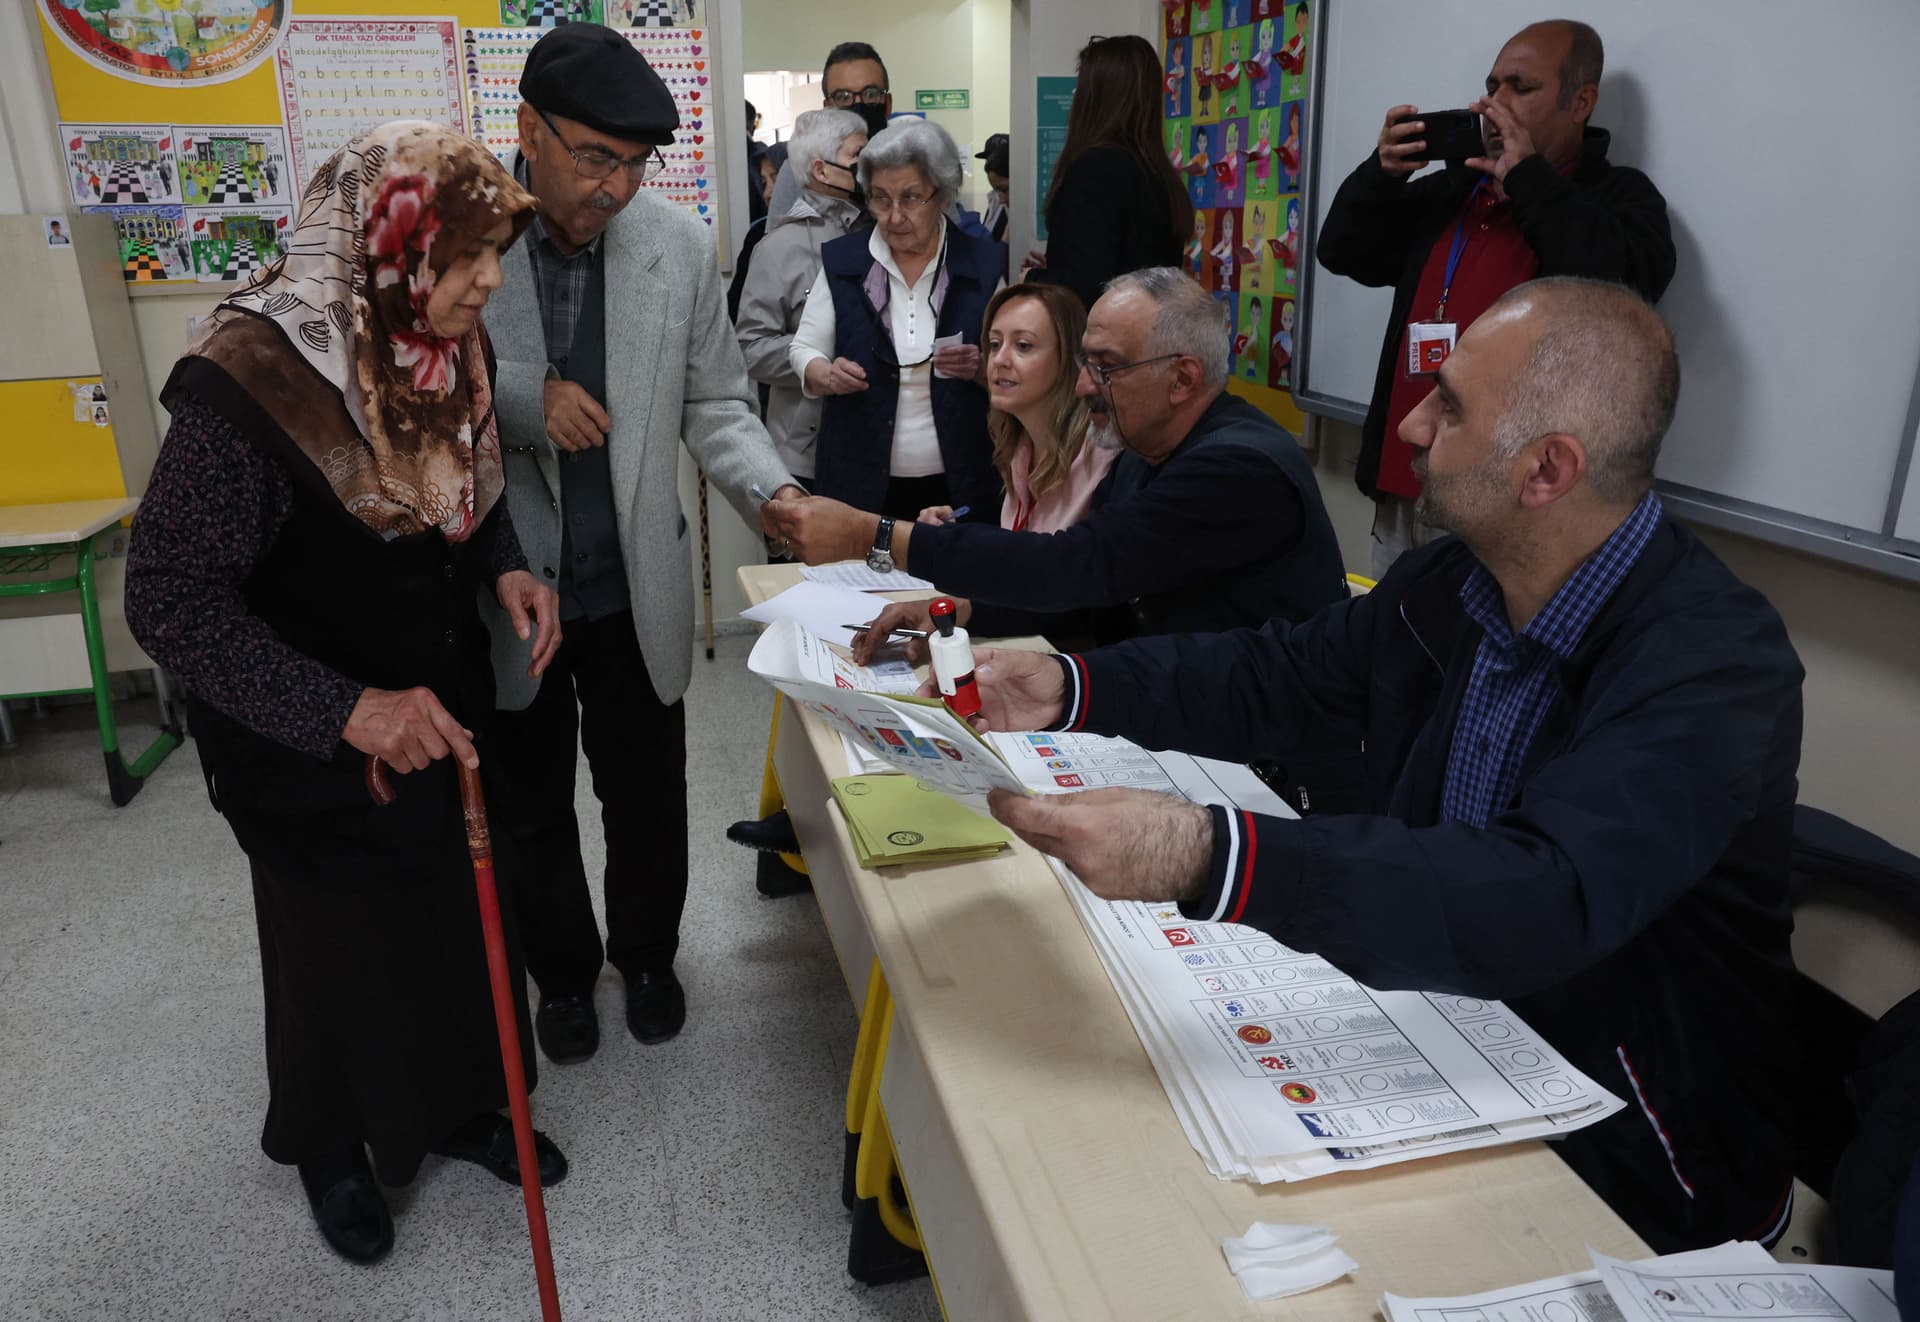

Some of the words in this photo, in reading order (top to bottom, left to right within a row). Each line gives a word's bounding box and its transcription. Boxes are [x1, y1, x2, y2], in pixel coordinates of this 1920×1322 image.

[195, 19, 267, 67] SONBAHAR
[245, 32, 274, 61] KASIM
[331, 34, 354, 42] TEMEL
[356, 34, 373, 42] YAZI
[204, 63, 233, 76] EKİM
[1411, 342, 1419, 371] PRESS
[1225, 1000, 1242, 1017] SOL
[1280, 1054, 1297, 1070] TKP
